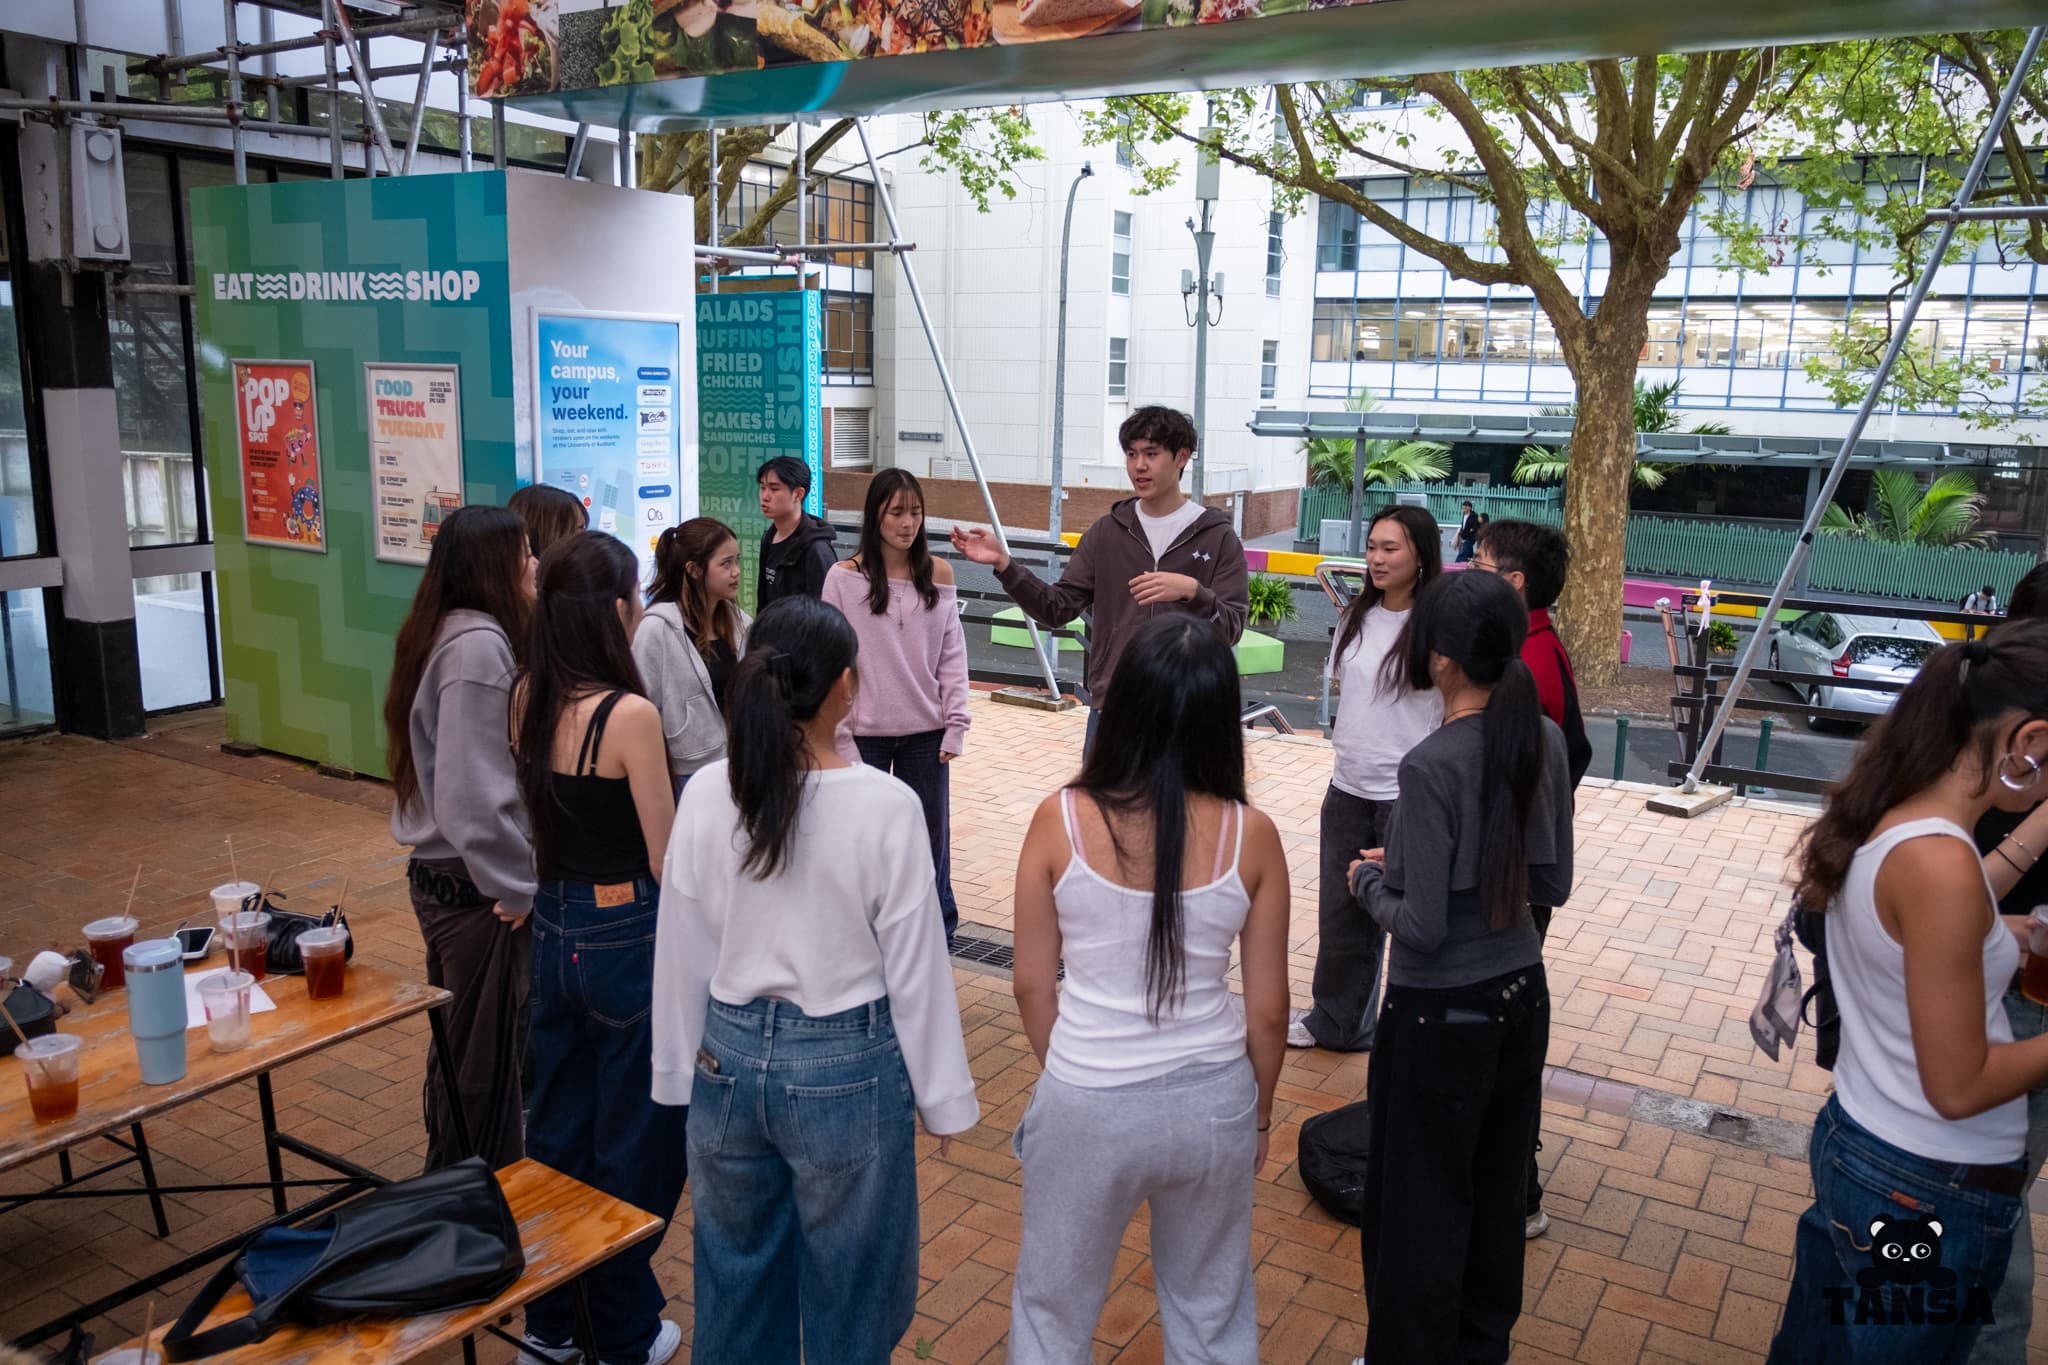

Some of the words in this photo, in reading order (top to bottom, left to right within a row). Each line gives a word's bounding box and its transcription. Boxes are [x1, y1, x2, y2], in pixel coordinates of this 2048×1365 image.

[213, 273, 254, 300] EAT
[289, 271, 368, 300] DRINK
[405, 270, 480, 301] SHOP
[697, 299, 774, 322] ALADS
[550, 340, 589, 358] Your
[702, 352, 762, 372] FRIED
[777, 298, 802, 431] SUSHI
[551, 365, 620, 384] campus,
[702, 375, 762, 388] CHICKEN
[244, 377, 290, 407] POP
[375, 379, 413, 397] FOOD
[552, 386, 590, 404] your
[376, 399, 426, 418] TRUCK
[552, 403, 628, 420] weekend.
[765, 393, 775, 429] PIES
[702, 411, 762, 429] CAKES
[248, 431, 269, 443] SPOT
[703, 431, 776, 444] SANDWICHES
[700, 495, 743, 513] URRY
[743, 560, 753, 616] ASTIES
